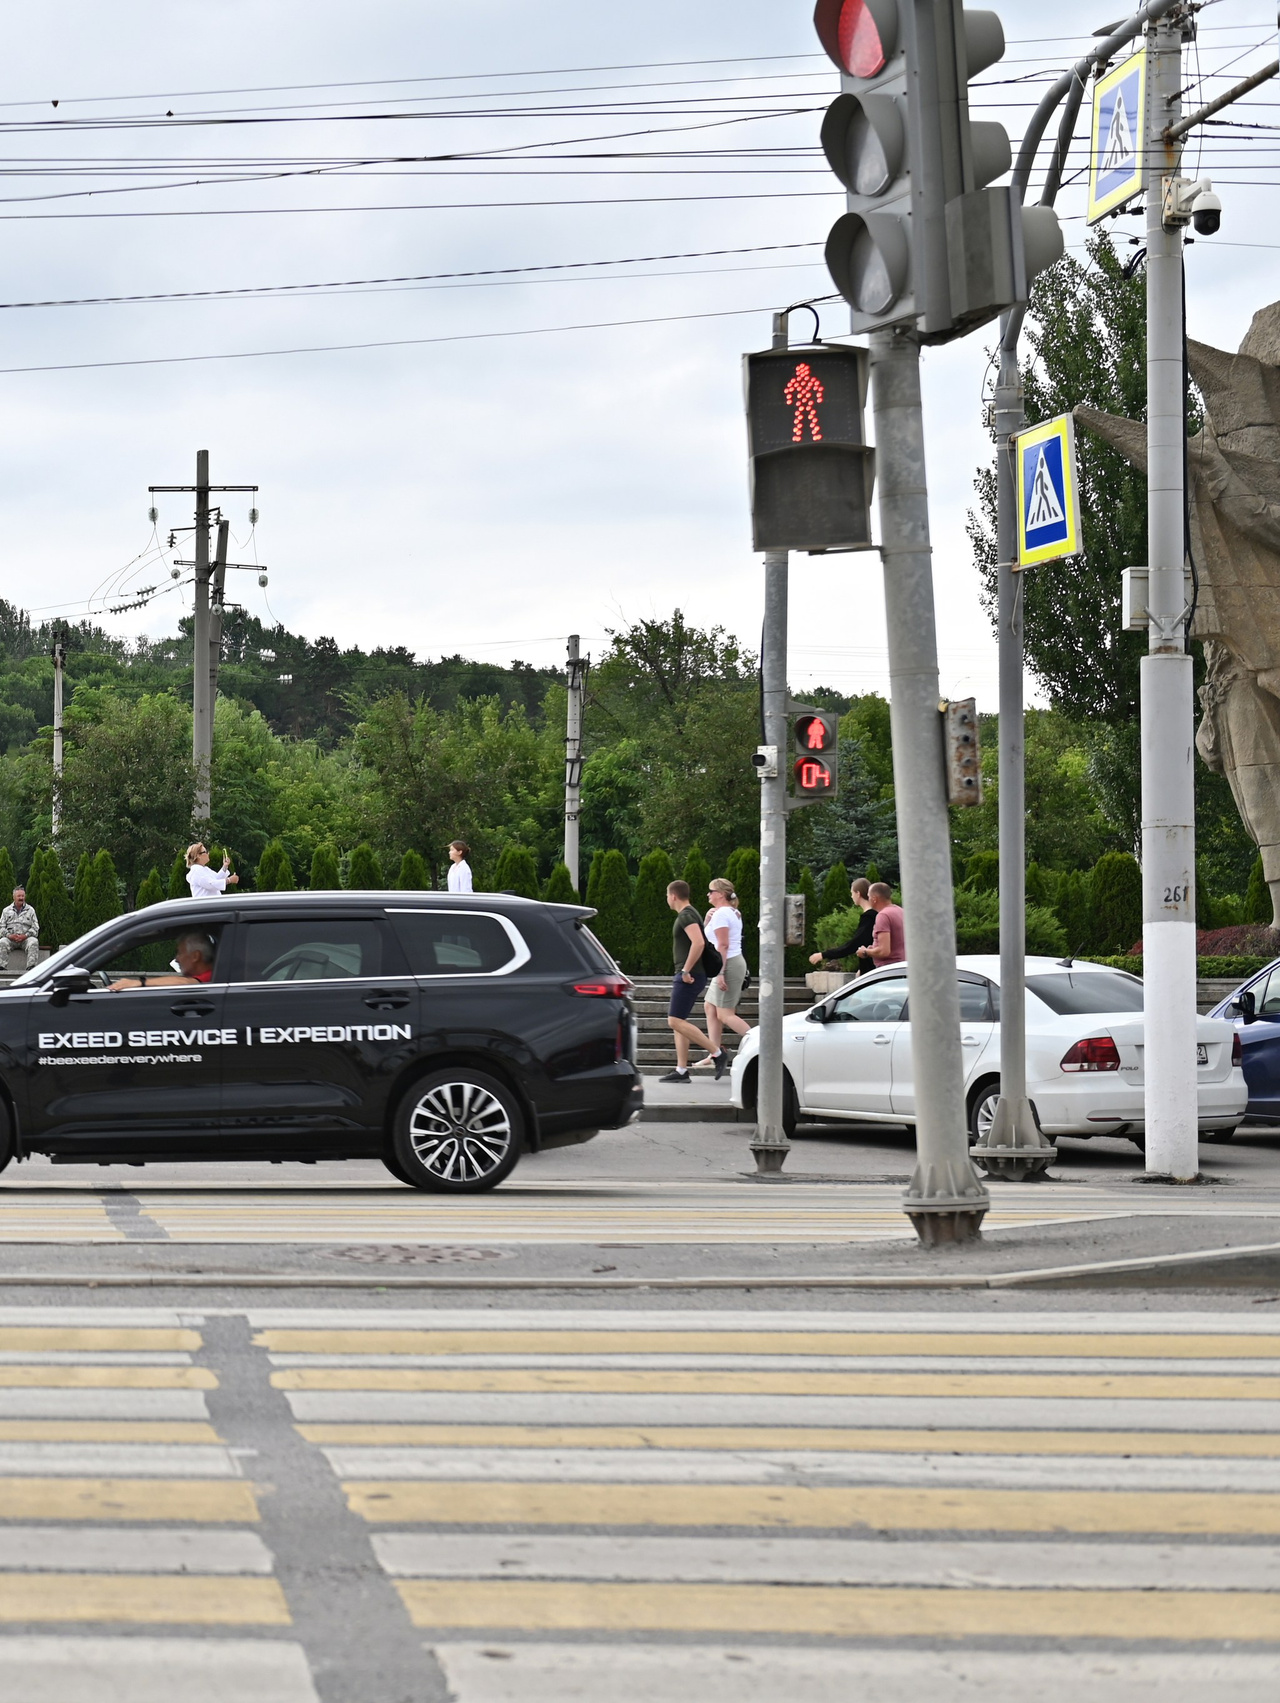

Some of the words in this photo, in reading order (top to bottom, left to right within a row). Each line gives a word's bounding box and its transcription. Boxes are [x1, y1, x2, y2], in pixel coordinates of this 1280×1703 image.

[802, 763, 830, 788] 04
[1164, 885, 1188, 902] 261
[38, 1031, 123, 1049] EXEED
[128, 1029, 238, 1047] SERVICE
[260, 1024, 412, 1044] EXPEDITION
[38, 1053, 203, 1066] #beexeedereverywhere
